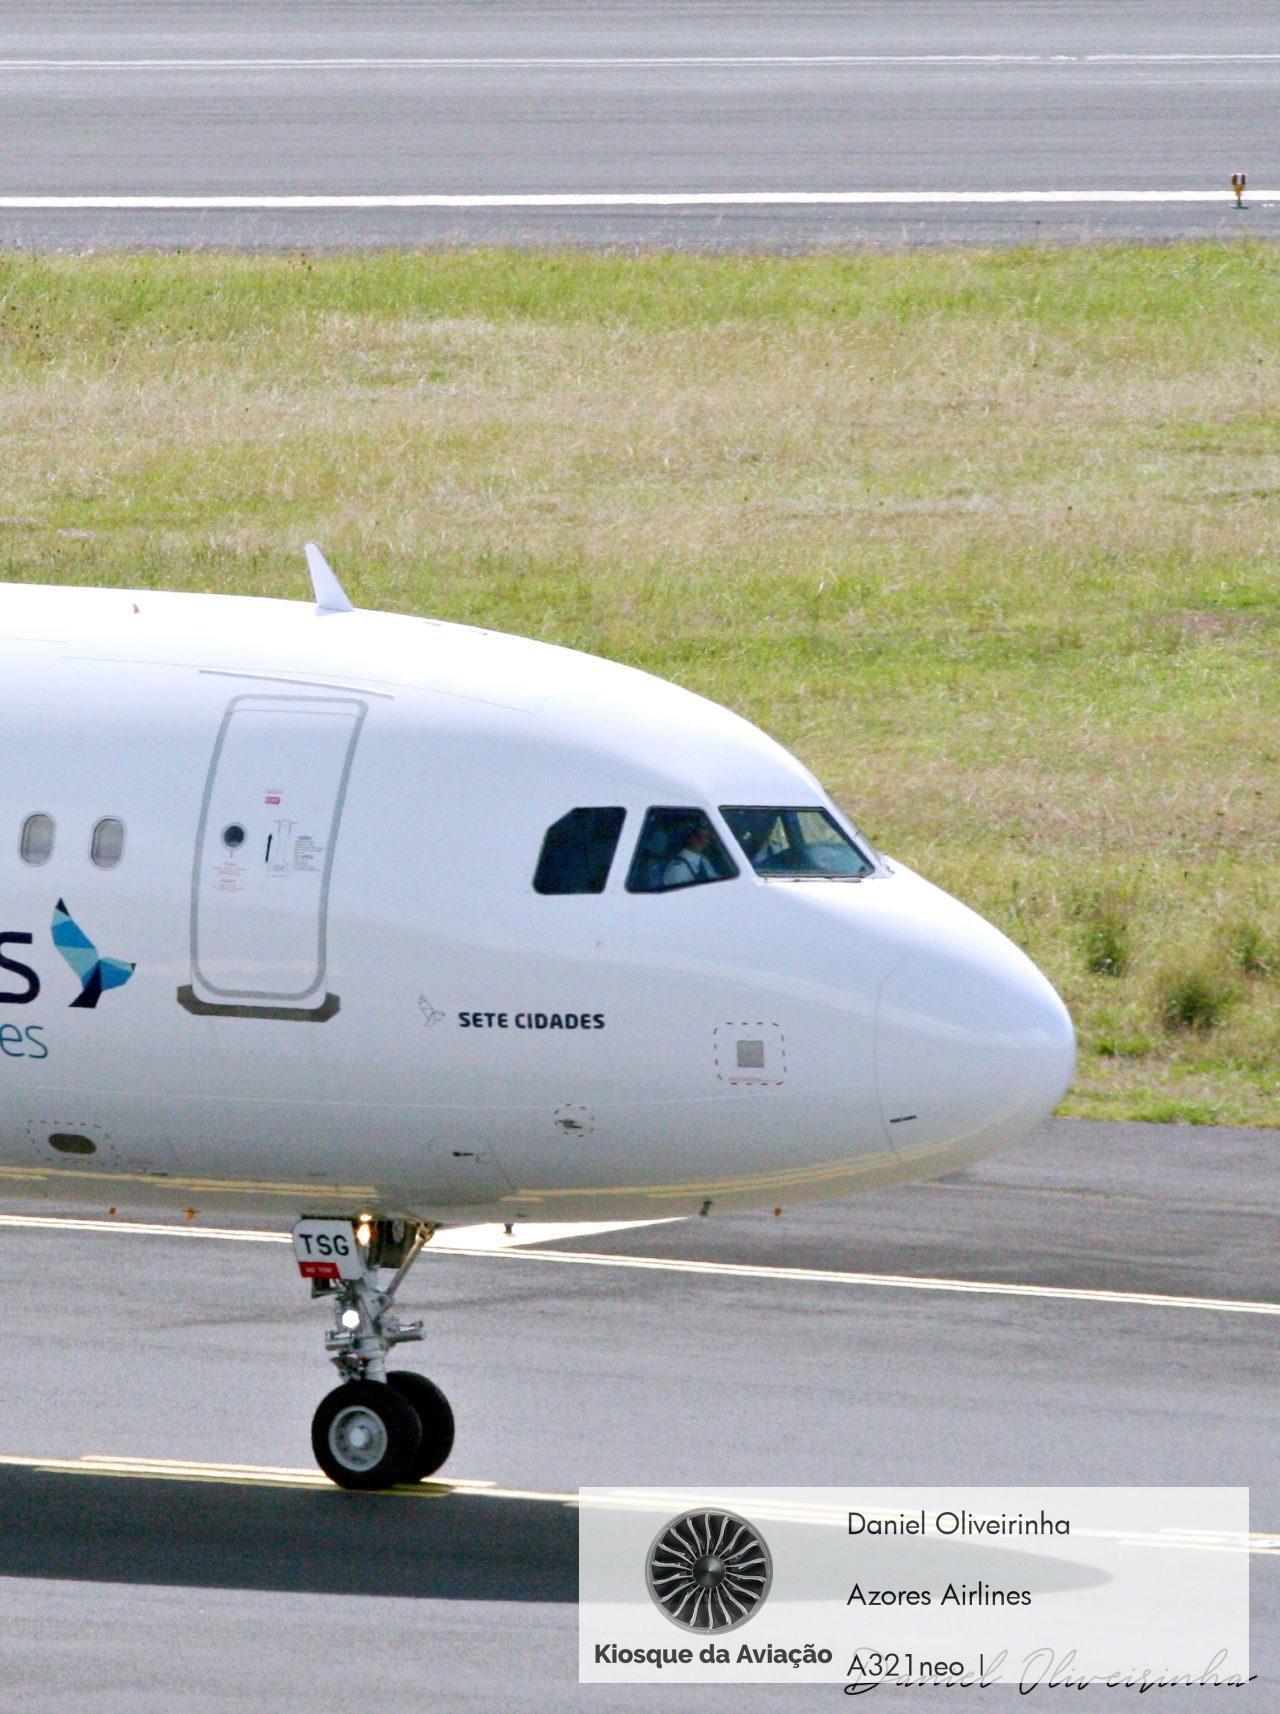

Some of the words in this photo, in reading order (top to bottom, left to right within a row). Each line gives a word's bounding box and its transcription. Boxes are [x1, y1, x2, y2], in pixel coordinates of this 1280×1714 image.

[458, 1011, 509, 1029] SETE
[514, 1012, 606, 1030] CIDADES
[298, 1233, 350, 1256] TSG
